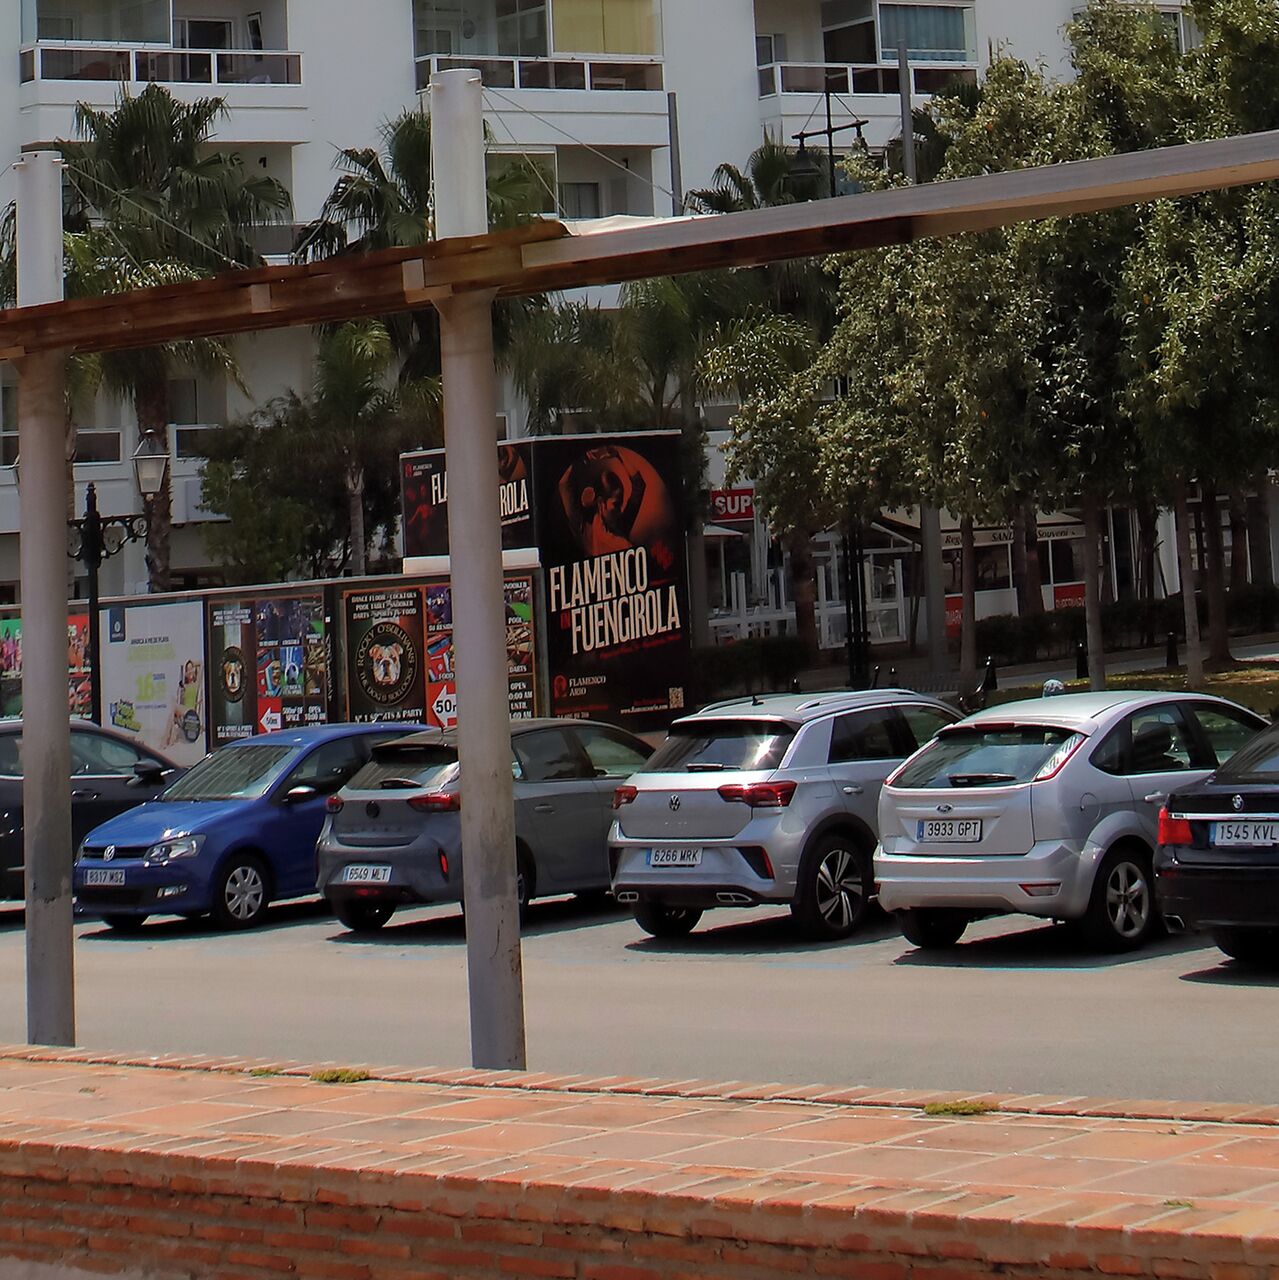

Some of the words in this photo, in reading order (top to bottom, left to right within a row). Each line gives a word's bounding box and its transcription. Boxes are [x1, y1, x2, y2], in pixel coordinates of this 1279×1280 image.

[1037, 527, 1076, 539] Souvenis
[549, 546, 648, 612] FLAMENCO
[571, 585, 681, 655] FUENGIROLA
[357, 631, 375, 667] ROCKY
[569, 675, 607, 688] FLAMENCO
[402, 708, 424, 718] PARTY
[927, 822, 954, 836] 3933
[957, 822, 979, 836] GPT
[1220, 825, 1249, 840] 1545
[1253, 825, 1277, 840] KVL
[654, 850, 678, 862] 6266
[680, 849, 699, 862] MRK
